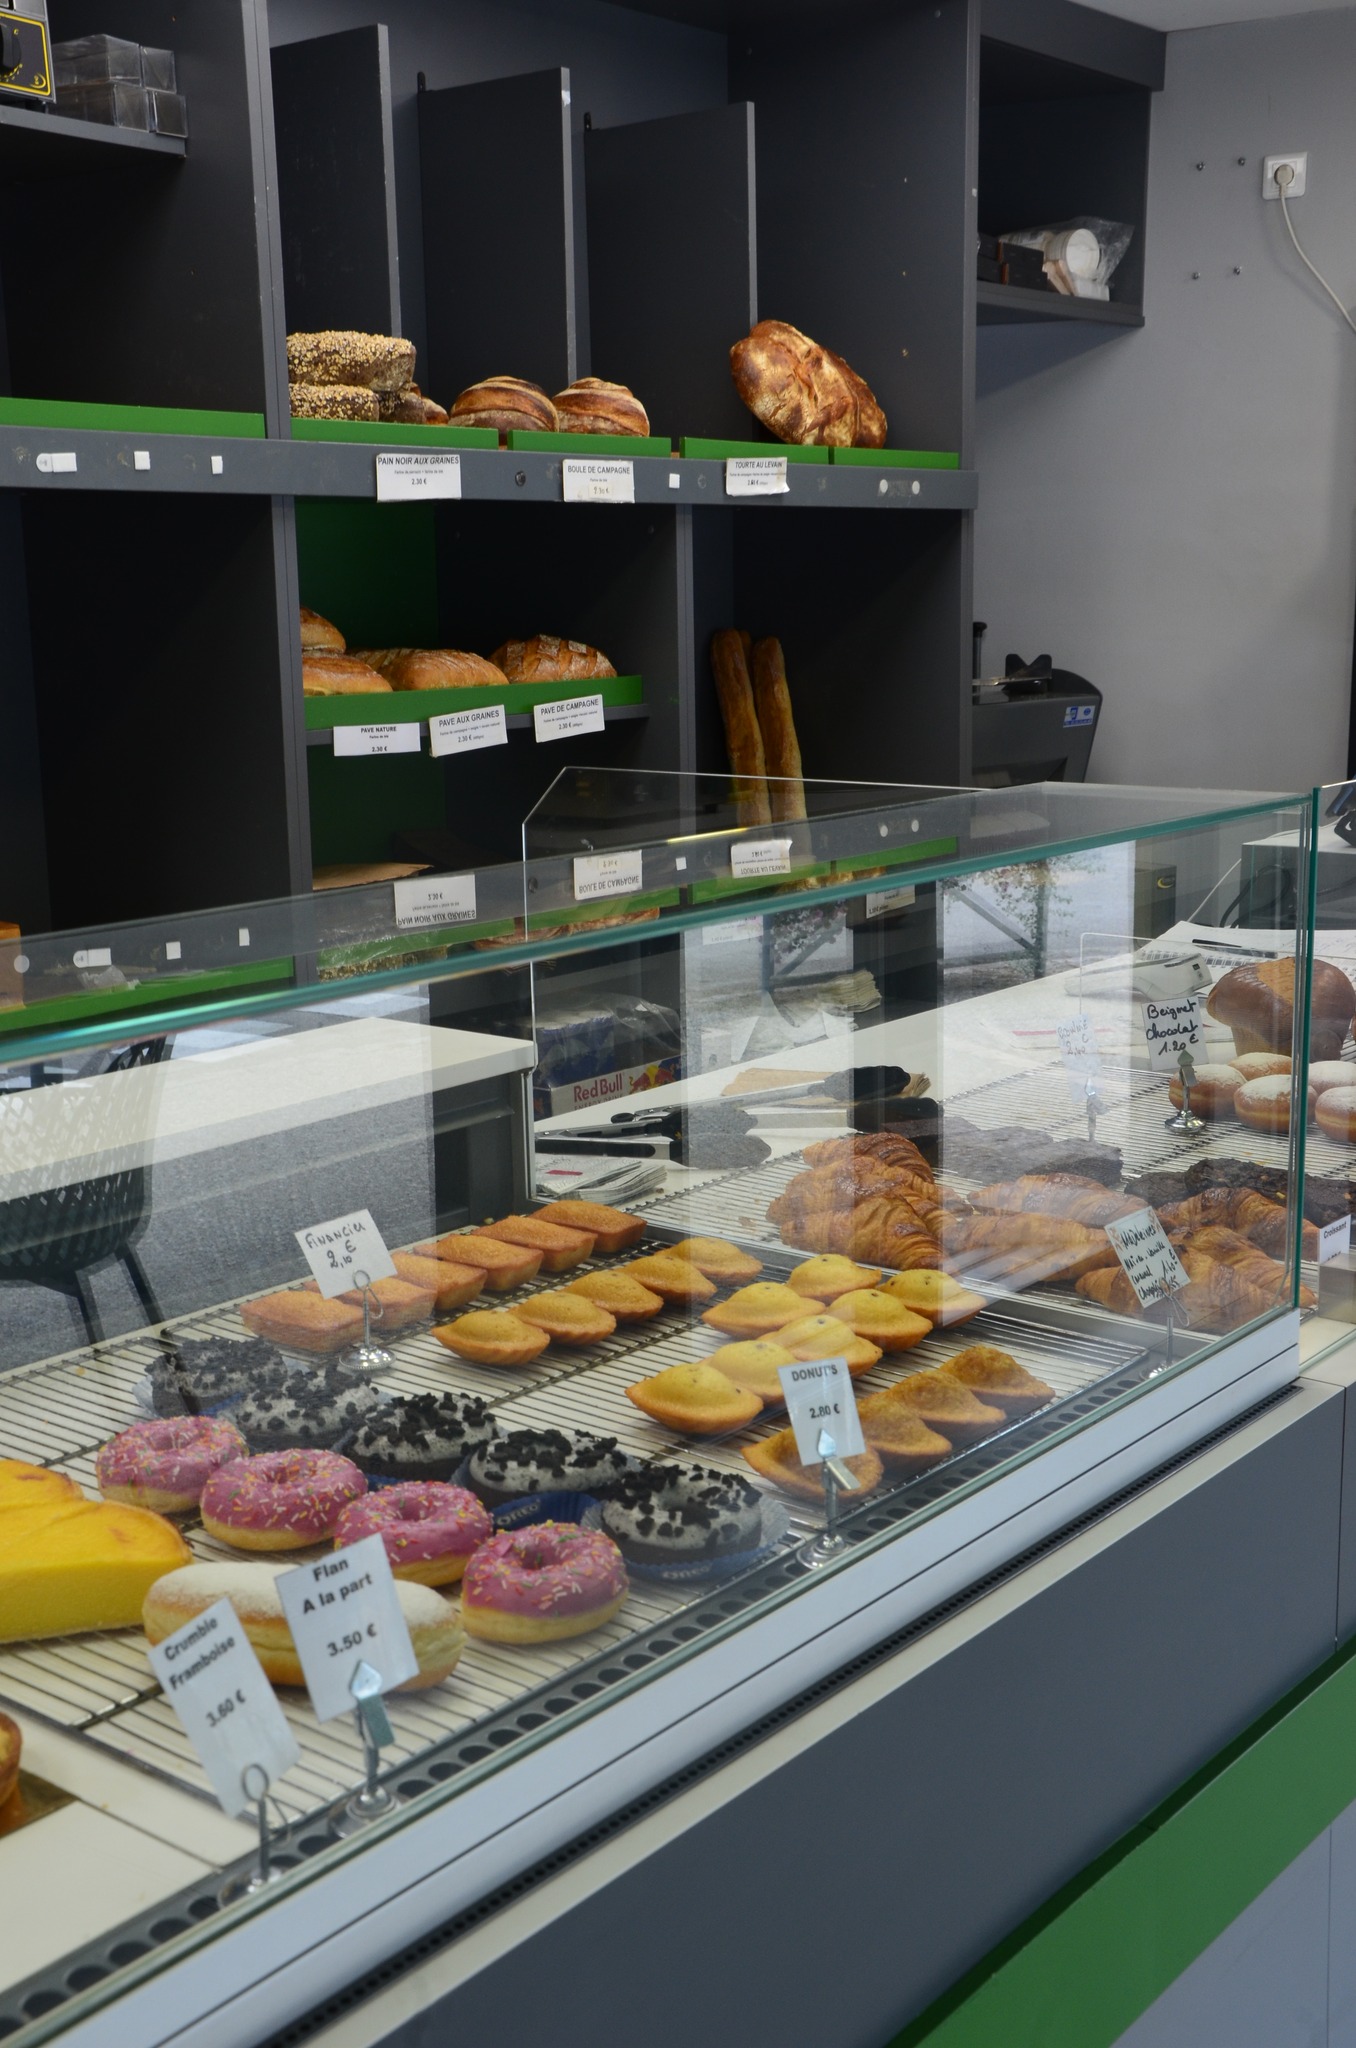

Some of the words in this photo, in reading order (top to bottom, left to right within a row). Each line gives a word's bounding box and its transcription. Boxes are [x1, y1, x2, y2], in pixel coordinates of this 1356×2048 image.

[377, 456, 394, 465] PAIN
[395, 456, 413, 465] NOIR
[413, 456, 429, 465] AUX
[429, 456, 460, 465] GRAINES
[567, 465, 586, 474] BOULE
[587, 466, 596, 474] DE
[596, 466, 631, 475] CAMPAGNE
[735, 461, 755, 469] TOURTE
[764, 460, 783, 468] LEVAIN
[540, 706, 556, 715] PAVE
[556, 704, 565, 713] DE
[565, 698, 599, 711] CAMPAGNE
[438, 717, 455, 728] PAVE
[456, 715, 470, 725] AUX
[471, 709, 500, 722] GRAINES
[1158, 1040, 1186, 1056] 1.20
[1189, 1033, 1199, 1044] €
[573, 1080, 598, 1102] Red
[600, 1072, 623, 1095] Bull
[1323, 1220, 1347, 1239] Croissant
[344, 1239, 357, 1253] €
[809, 1405, 831, 1419] 2.80
[833, 1403, 840, 1415] €
[312, 1559, 349, 1583] Flan
[303, 1597, 316, 1615] A
[318, 1591, 336, 1607] la
[339, 1573, 373, 1601] part
[164, 1618, 218, 1661] Crumble
[326, 1630, 363, 1658] 3.50
[366, 1623, 377, 1638] €
[168, 1636, 236, 1690] Framboise
[206, 1698, 235, 1728] 3.60
[235, 1688, 246, 1704] €
